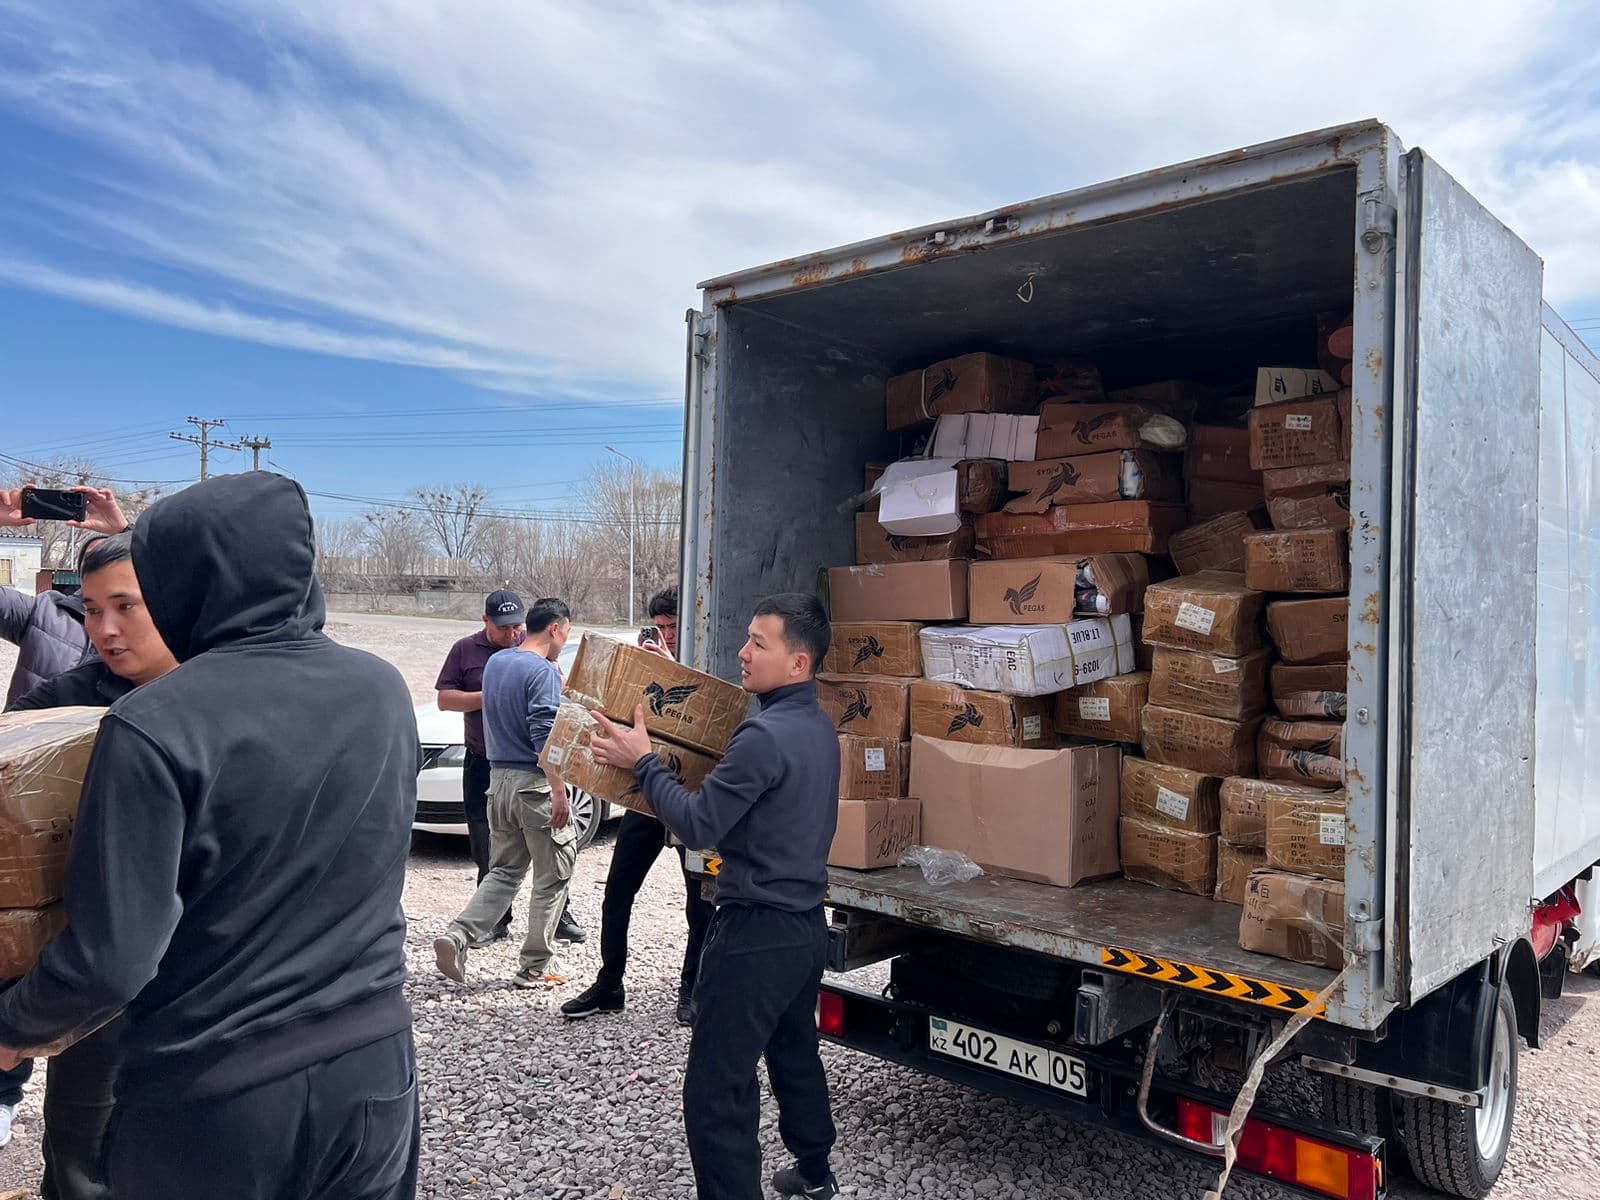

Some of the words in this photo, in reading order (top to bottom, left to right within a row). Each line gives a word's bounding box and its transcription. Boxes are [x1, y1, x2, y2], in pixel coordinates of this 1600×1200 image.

[1023, 604, 1046, 612] PEGAS
[1071, 628, 1101, 644] LT.BLUE
[1006, 651, 1017, 671] EAC
[665, 707, 694, 724] PEGAS
[932, 1036, 947, 1050] KZ
[952, 1028, 998, 1066] 402
[1008, 1049, 1038, 1078] AK
[1052, 1055, 1084, 1090] 05
